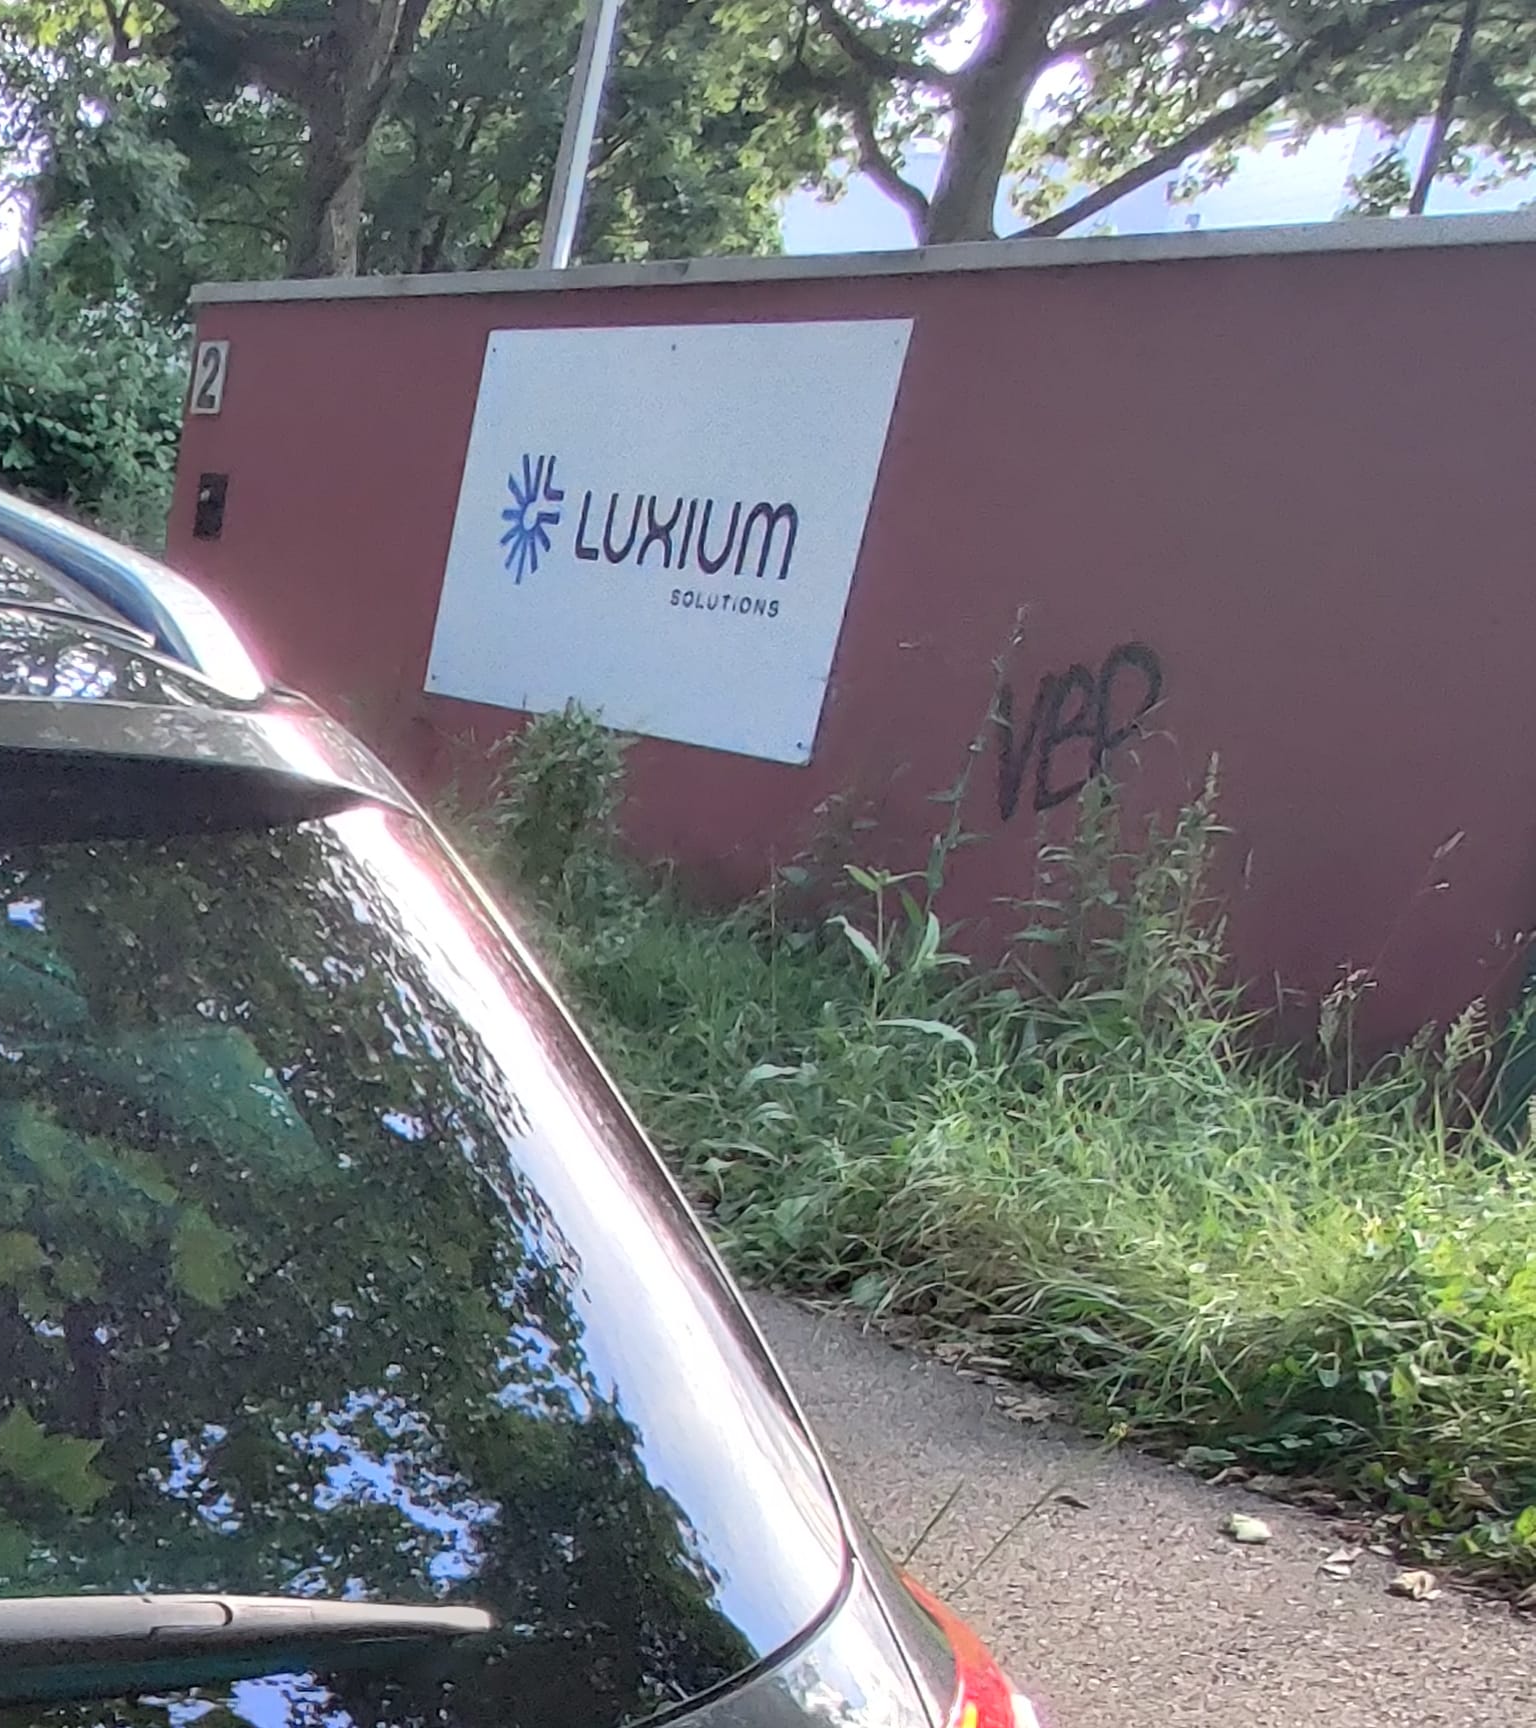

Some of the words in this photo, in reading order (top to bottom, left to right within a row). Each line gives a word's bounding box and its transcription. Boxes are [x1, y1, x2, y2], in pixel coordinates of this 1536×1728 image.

[197, 346, 221, 409] 2
[575, 489, 798, 580] LUXIUM
[670, 588, 780, 619] SOLUTIONS
